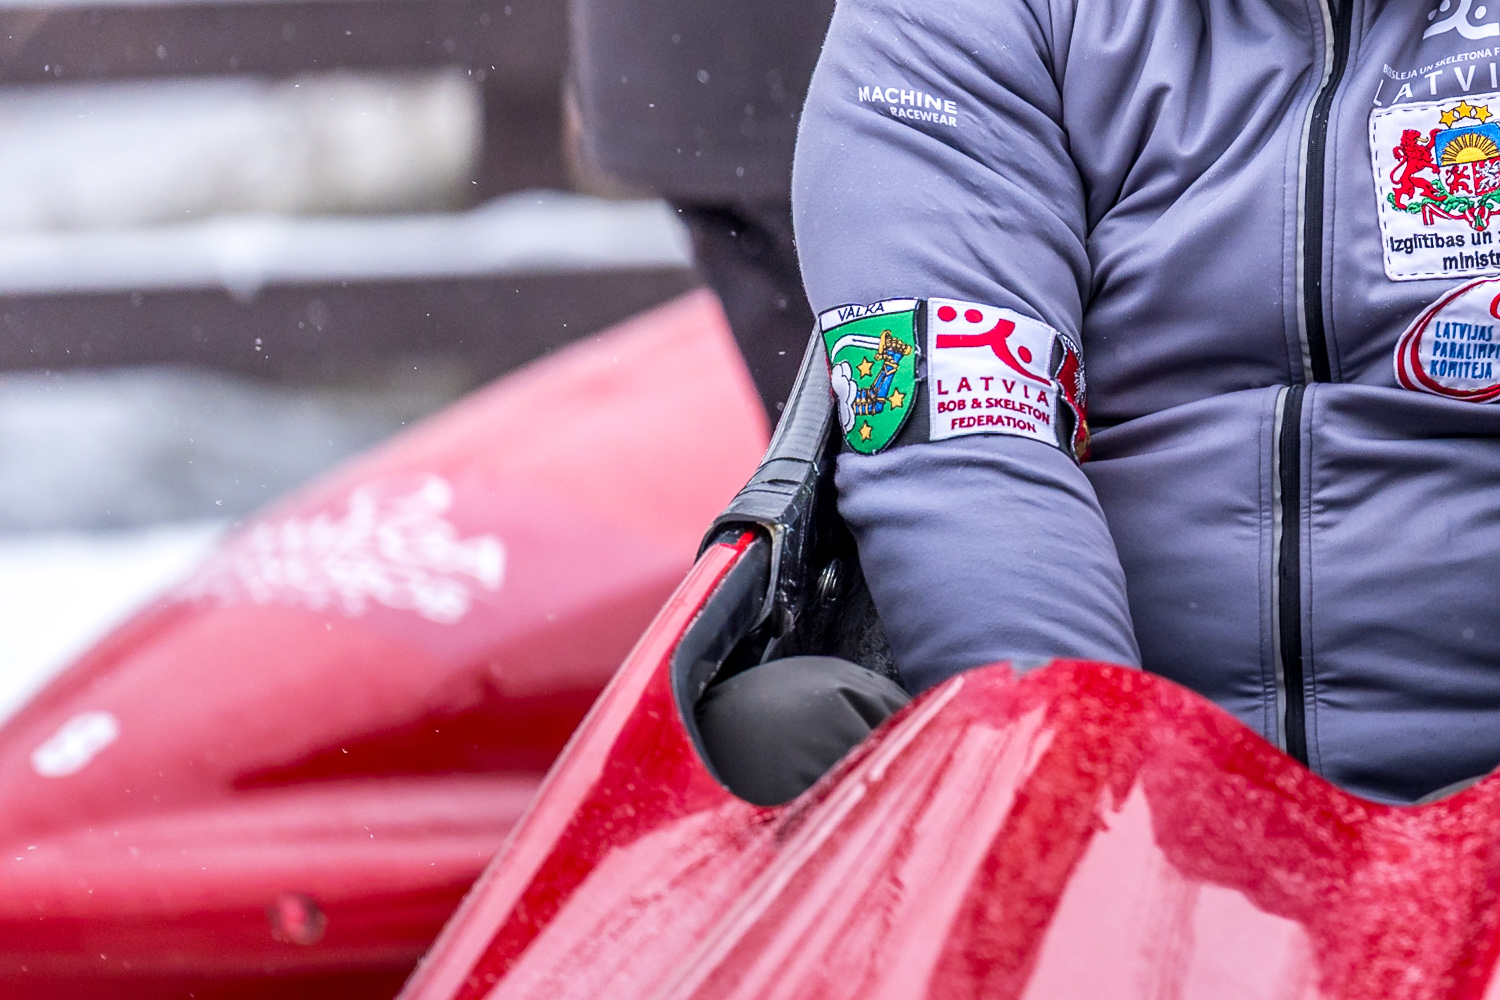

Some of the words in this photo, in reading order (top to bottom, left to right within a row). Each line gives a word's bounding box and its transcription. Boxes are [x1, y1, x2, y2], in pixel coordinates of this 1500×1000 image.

[1419, 64, 1434, 75] UN
[1434, 47, 1493, 69] SKELETONA
[858, 85, 958, 115] MACHINE
[889, 106, 957, 127] RACEWEAR
[1471, 230, 1493, 246] un
[838, 301, 885, 321] VALKA
[1435, 320, 1494, 342] LATVIJAS
[1429, 359, 1493, 380] KOMITEJA
[937, 376, 1050, 408] LATVIA
[937, 399, 967, 414] BOB
[971, 397, 983, 410] &
[985, 397, 1051, 426] SKELETON
[951, 414, 1038, 434] FEDERATION
